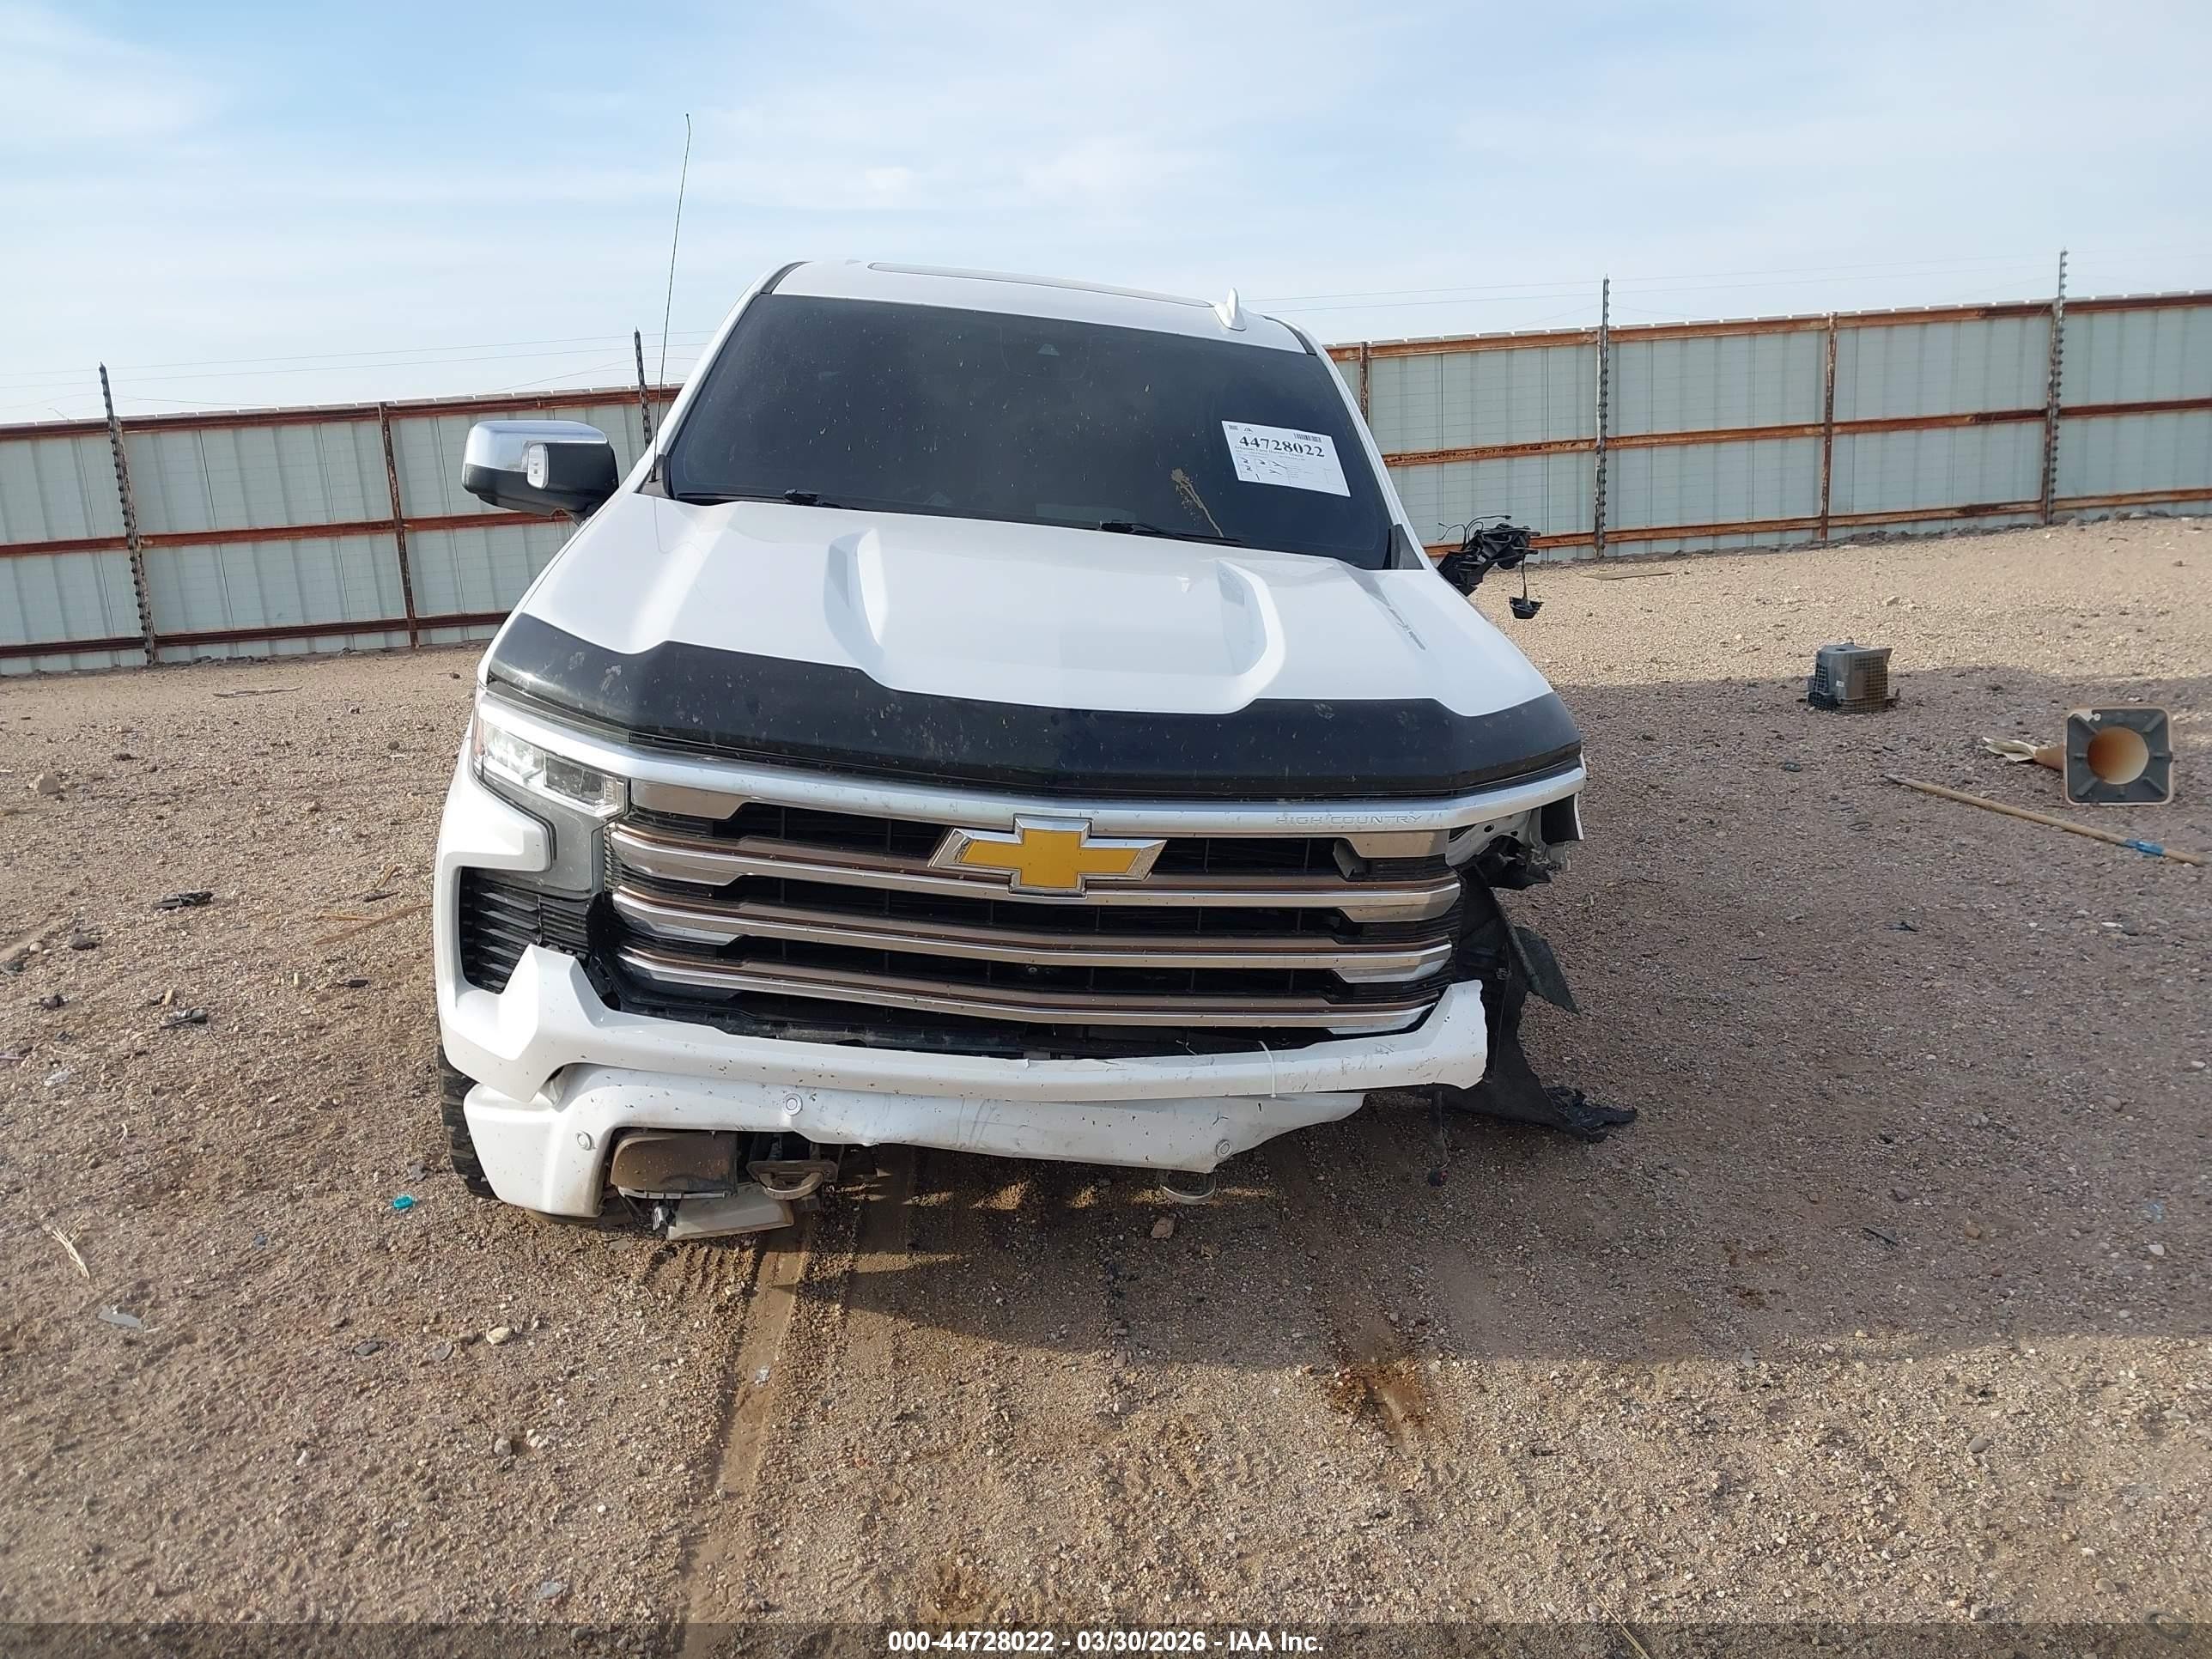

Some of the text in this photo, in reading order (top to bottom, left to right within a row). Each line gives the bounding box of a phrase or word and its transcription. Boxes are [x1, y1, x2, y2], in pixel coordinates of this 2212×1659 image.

[1239, 436, 1325, 458] 44728022
[1275, 815, 1423, 825] HIGH COUNTRY
